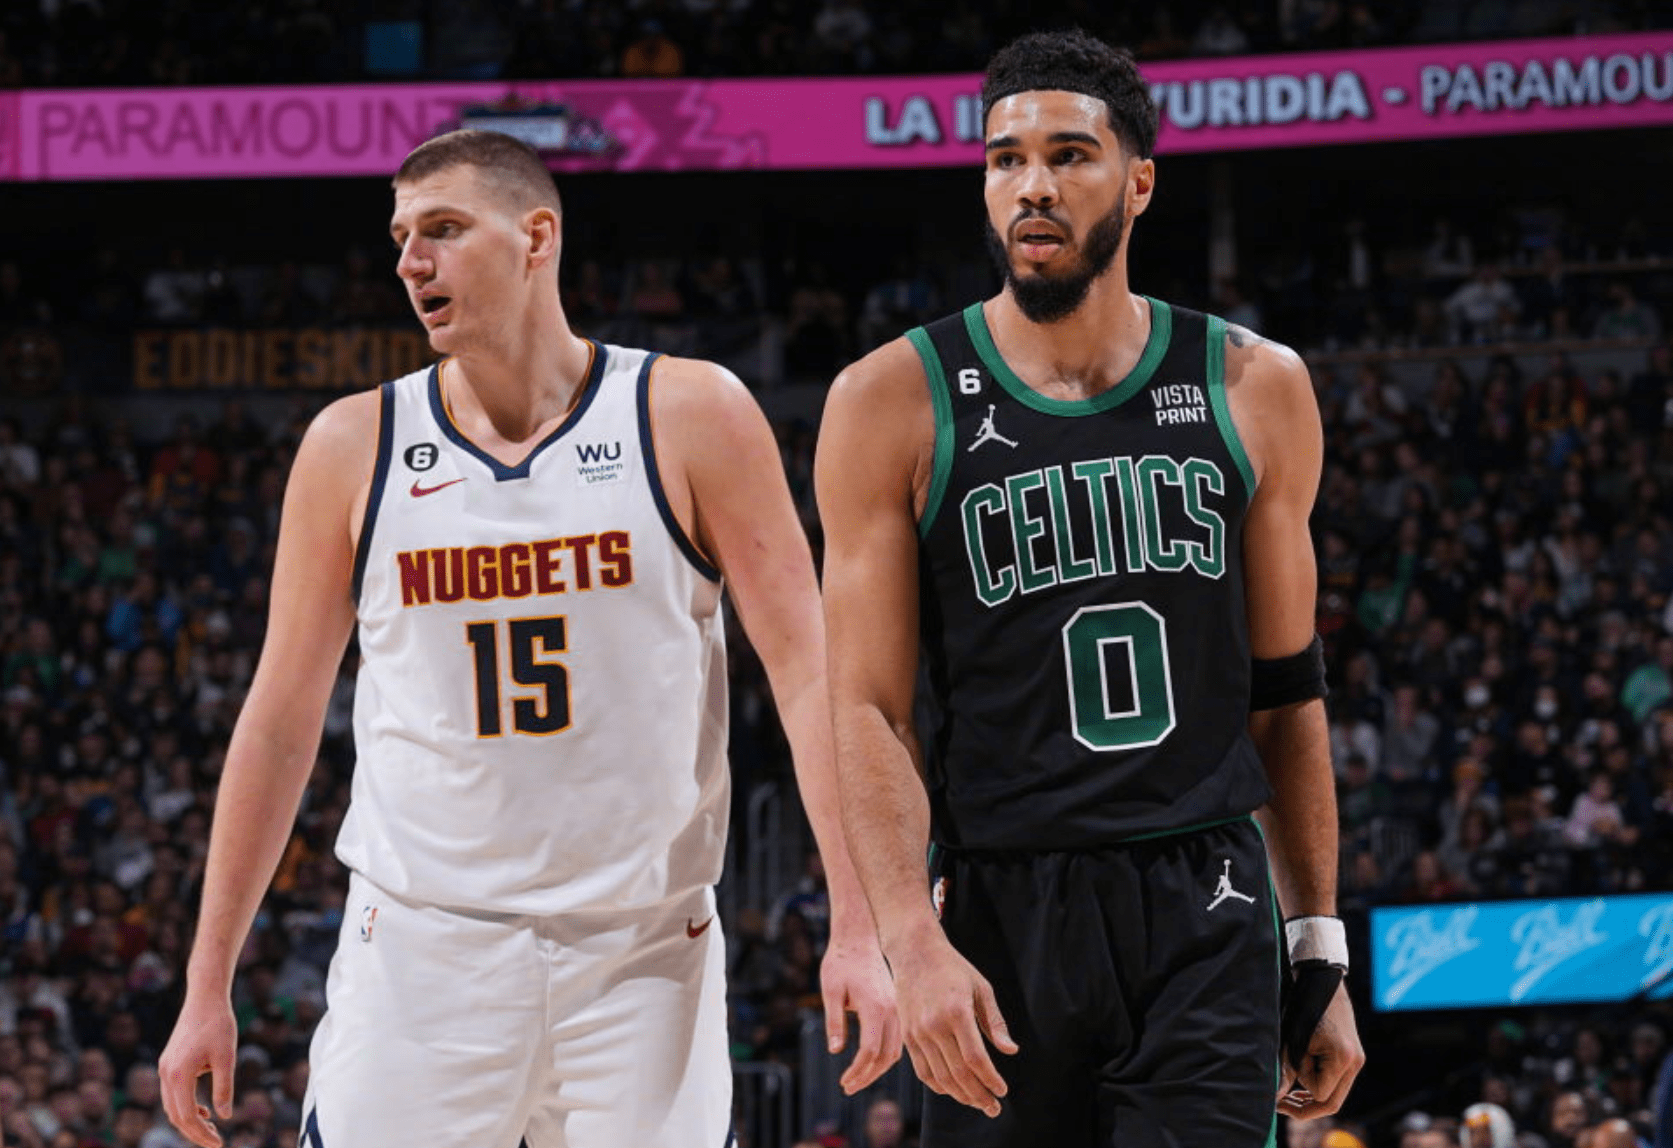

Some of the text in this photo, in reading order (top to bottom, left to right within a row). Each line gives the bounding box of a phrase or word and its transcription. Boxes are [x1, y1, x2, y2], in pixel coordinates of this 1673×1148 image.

[865, 95, 941, 143] LA
[1421, 52, 1673, 115] PARAMOU
[958, 368, 981, 394] 6
[1151, 384, 1205, 408] VISTA
[1155, 407, 1207, 426] PRINT
[411, 446, 433, 469] 6
[575, 441, 621, 463] WU
[577, 463, 623, 475] Western
[585, 473, 618, 484] Union
[960, 454, 1225, 608] CELTICS
[397, 530, 635, 608] NUGGETS
[465, 614, 573, 739] 15
[1062, 600, 1177, 752] 0
